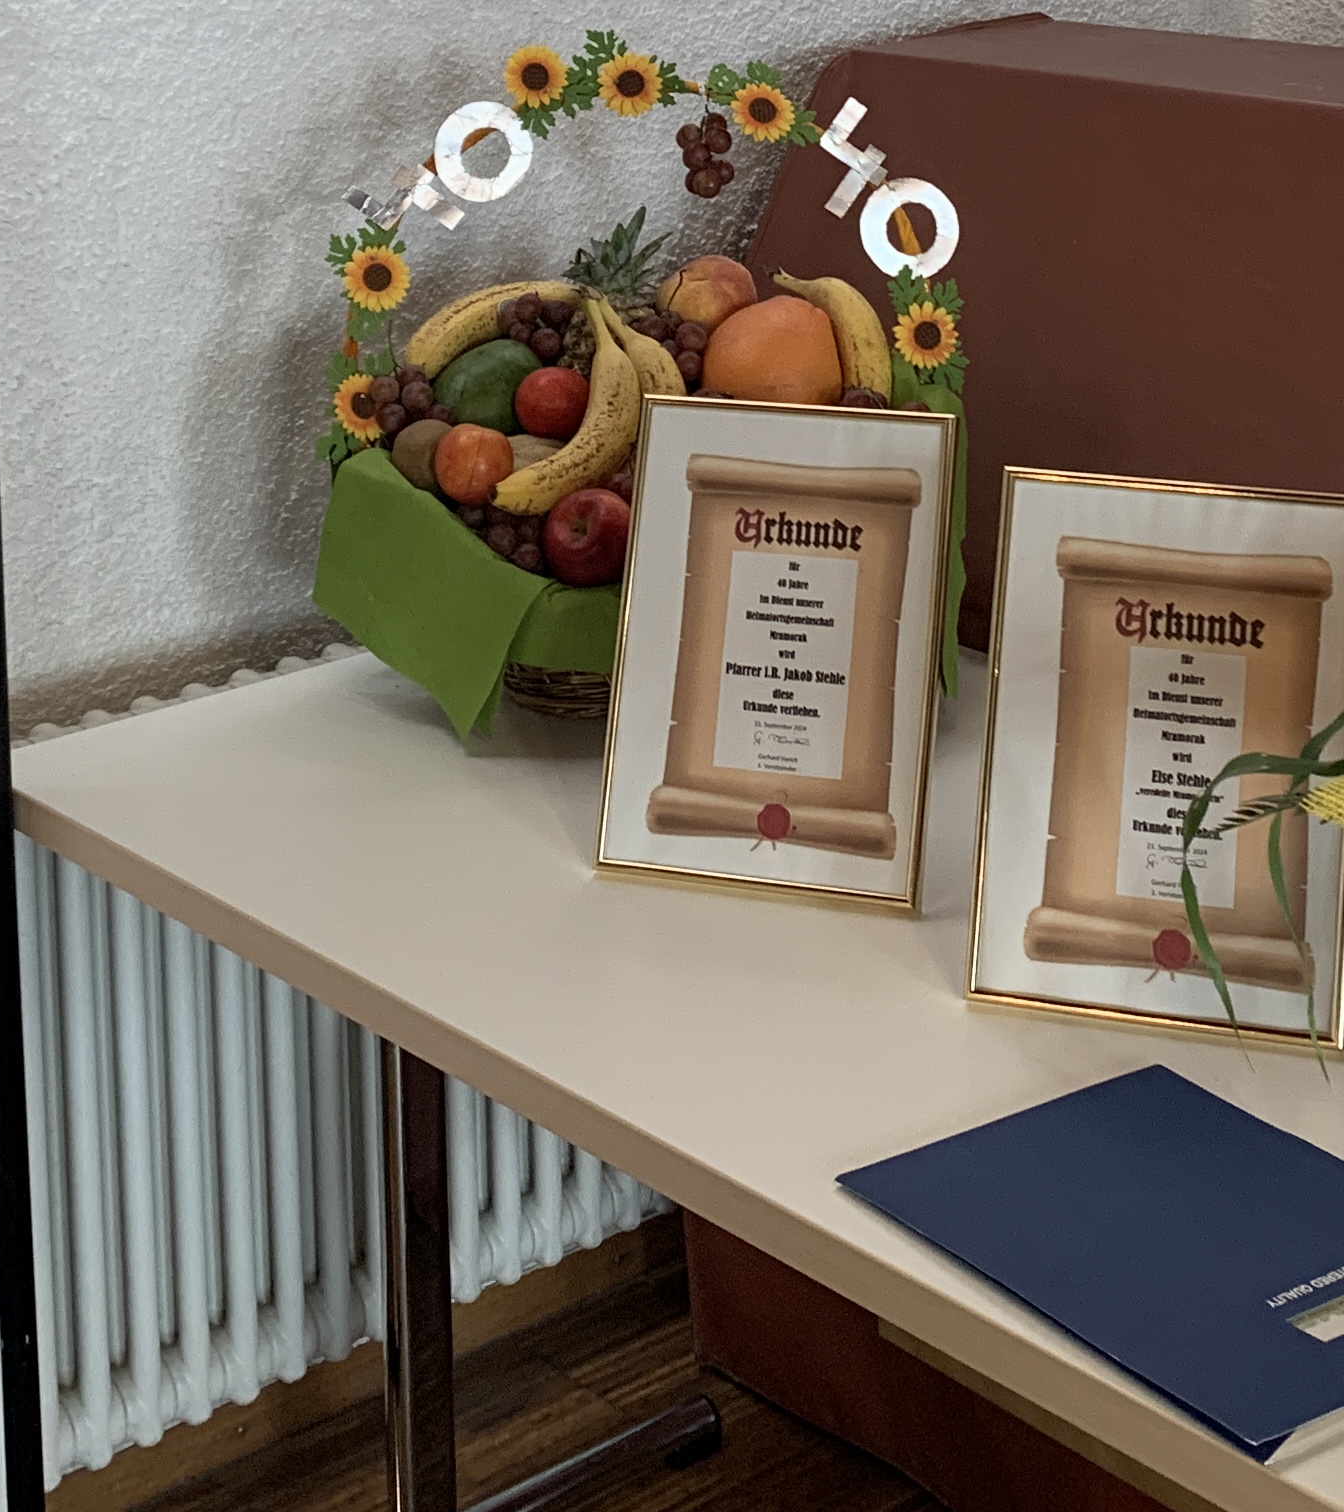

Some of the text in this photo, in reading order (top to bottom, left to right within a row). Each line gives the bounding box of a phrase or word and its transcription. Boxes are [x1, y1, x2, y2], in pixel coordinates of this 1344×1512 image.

[725, 662, 762, 678] Pfarrer
[783, 668, 812, 682] Jakob
[815, 670, 846, 686] Stehle
[1151, 769, 1211, 788] Else Stehle
[1167, 807, 1186, 820] dies
[1132, 819, 1172, 835] Urkunde
[1265, 1283, 1314, 1309] QUALITY
